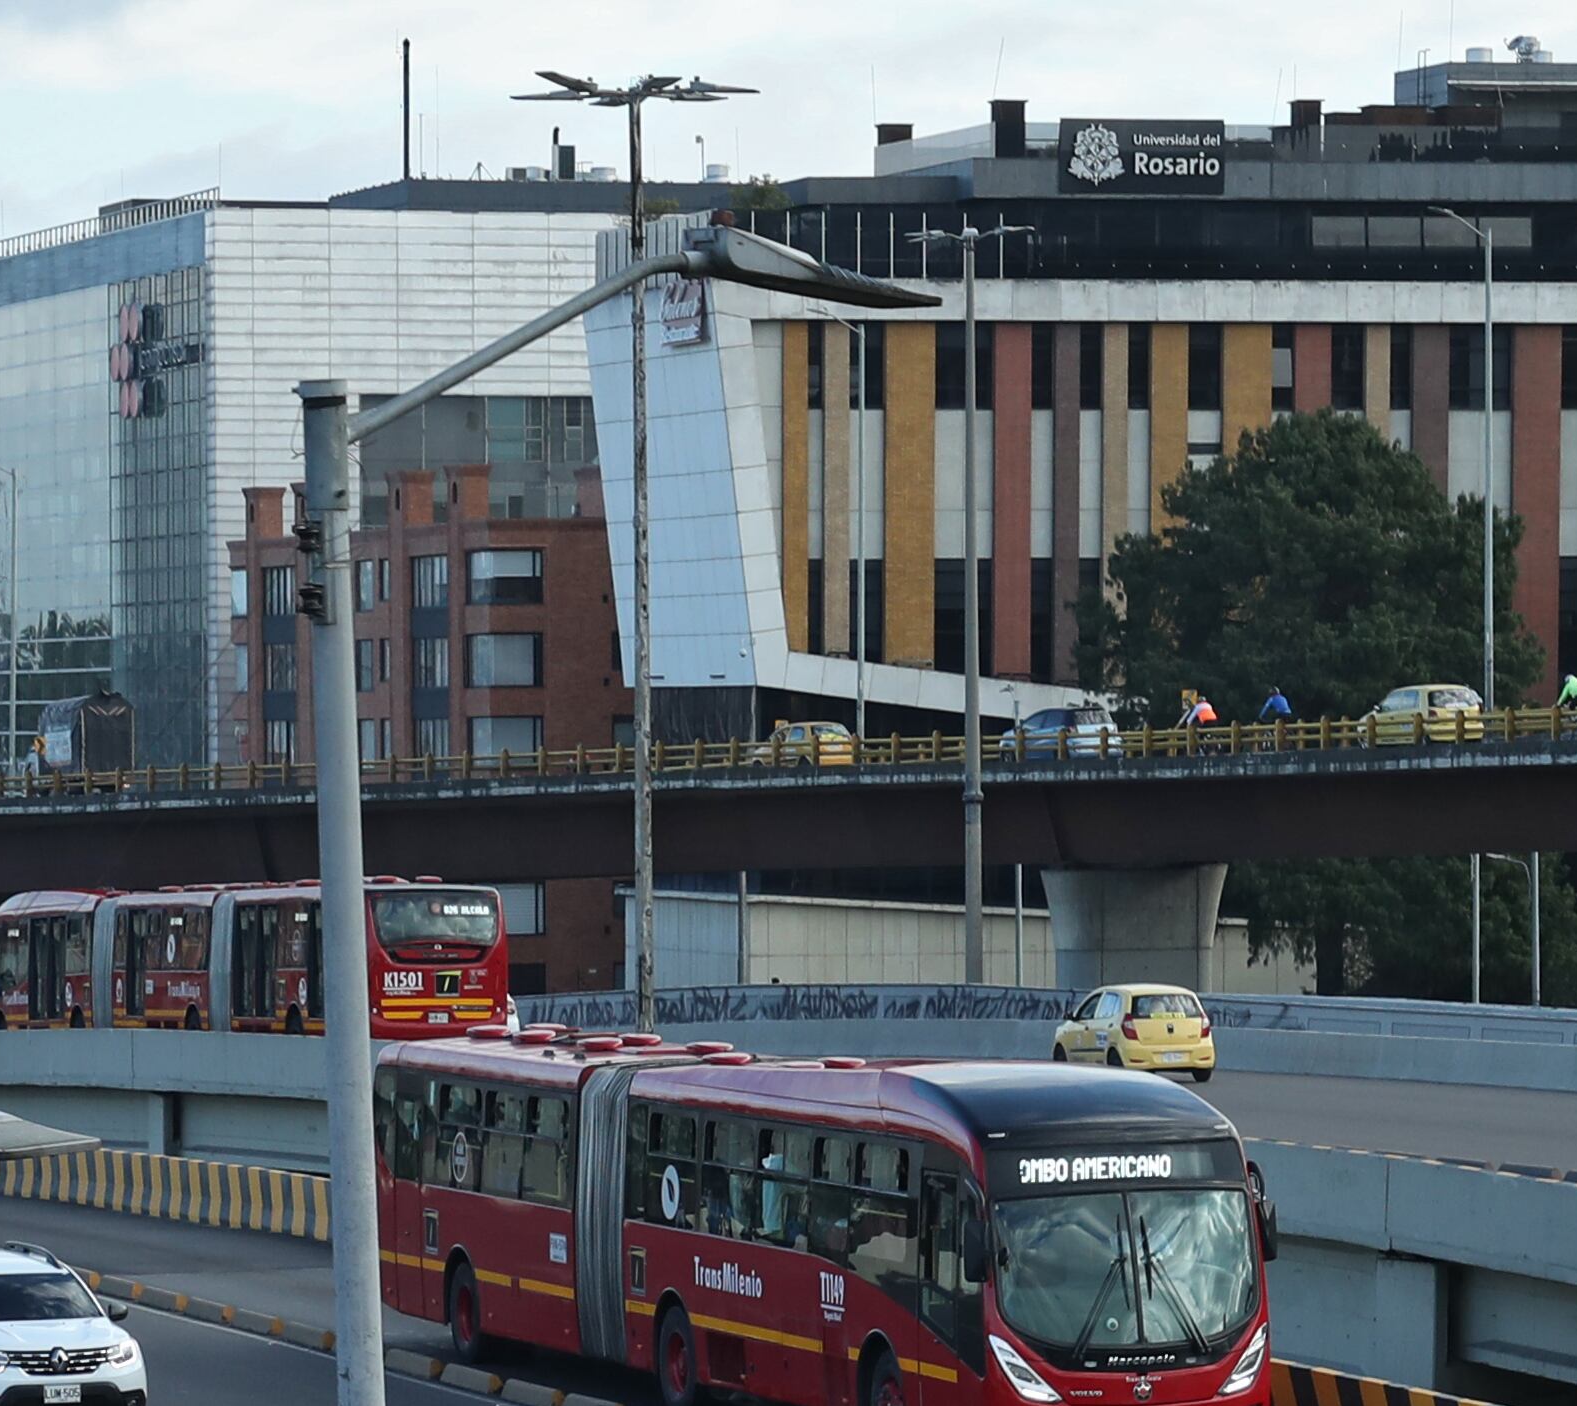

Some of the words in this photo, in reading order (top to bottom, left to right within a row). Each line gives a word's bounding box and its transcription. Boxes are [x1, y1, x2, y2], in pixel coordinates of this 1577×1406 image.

[1133, 133, 1199, 147] Universidad
[1203, 133, 1220, 147] del
[1134, 151, 1220, 176] Rosario
[384, 971, 423, 988] K1501
[1072, 1154, 1172, 1182] AMERICANO
[694, 1256, 763, 1298] TransMilenio
[820, 1271, 845, 1306] T1149
